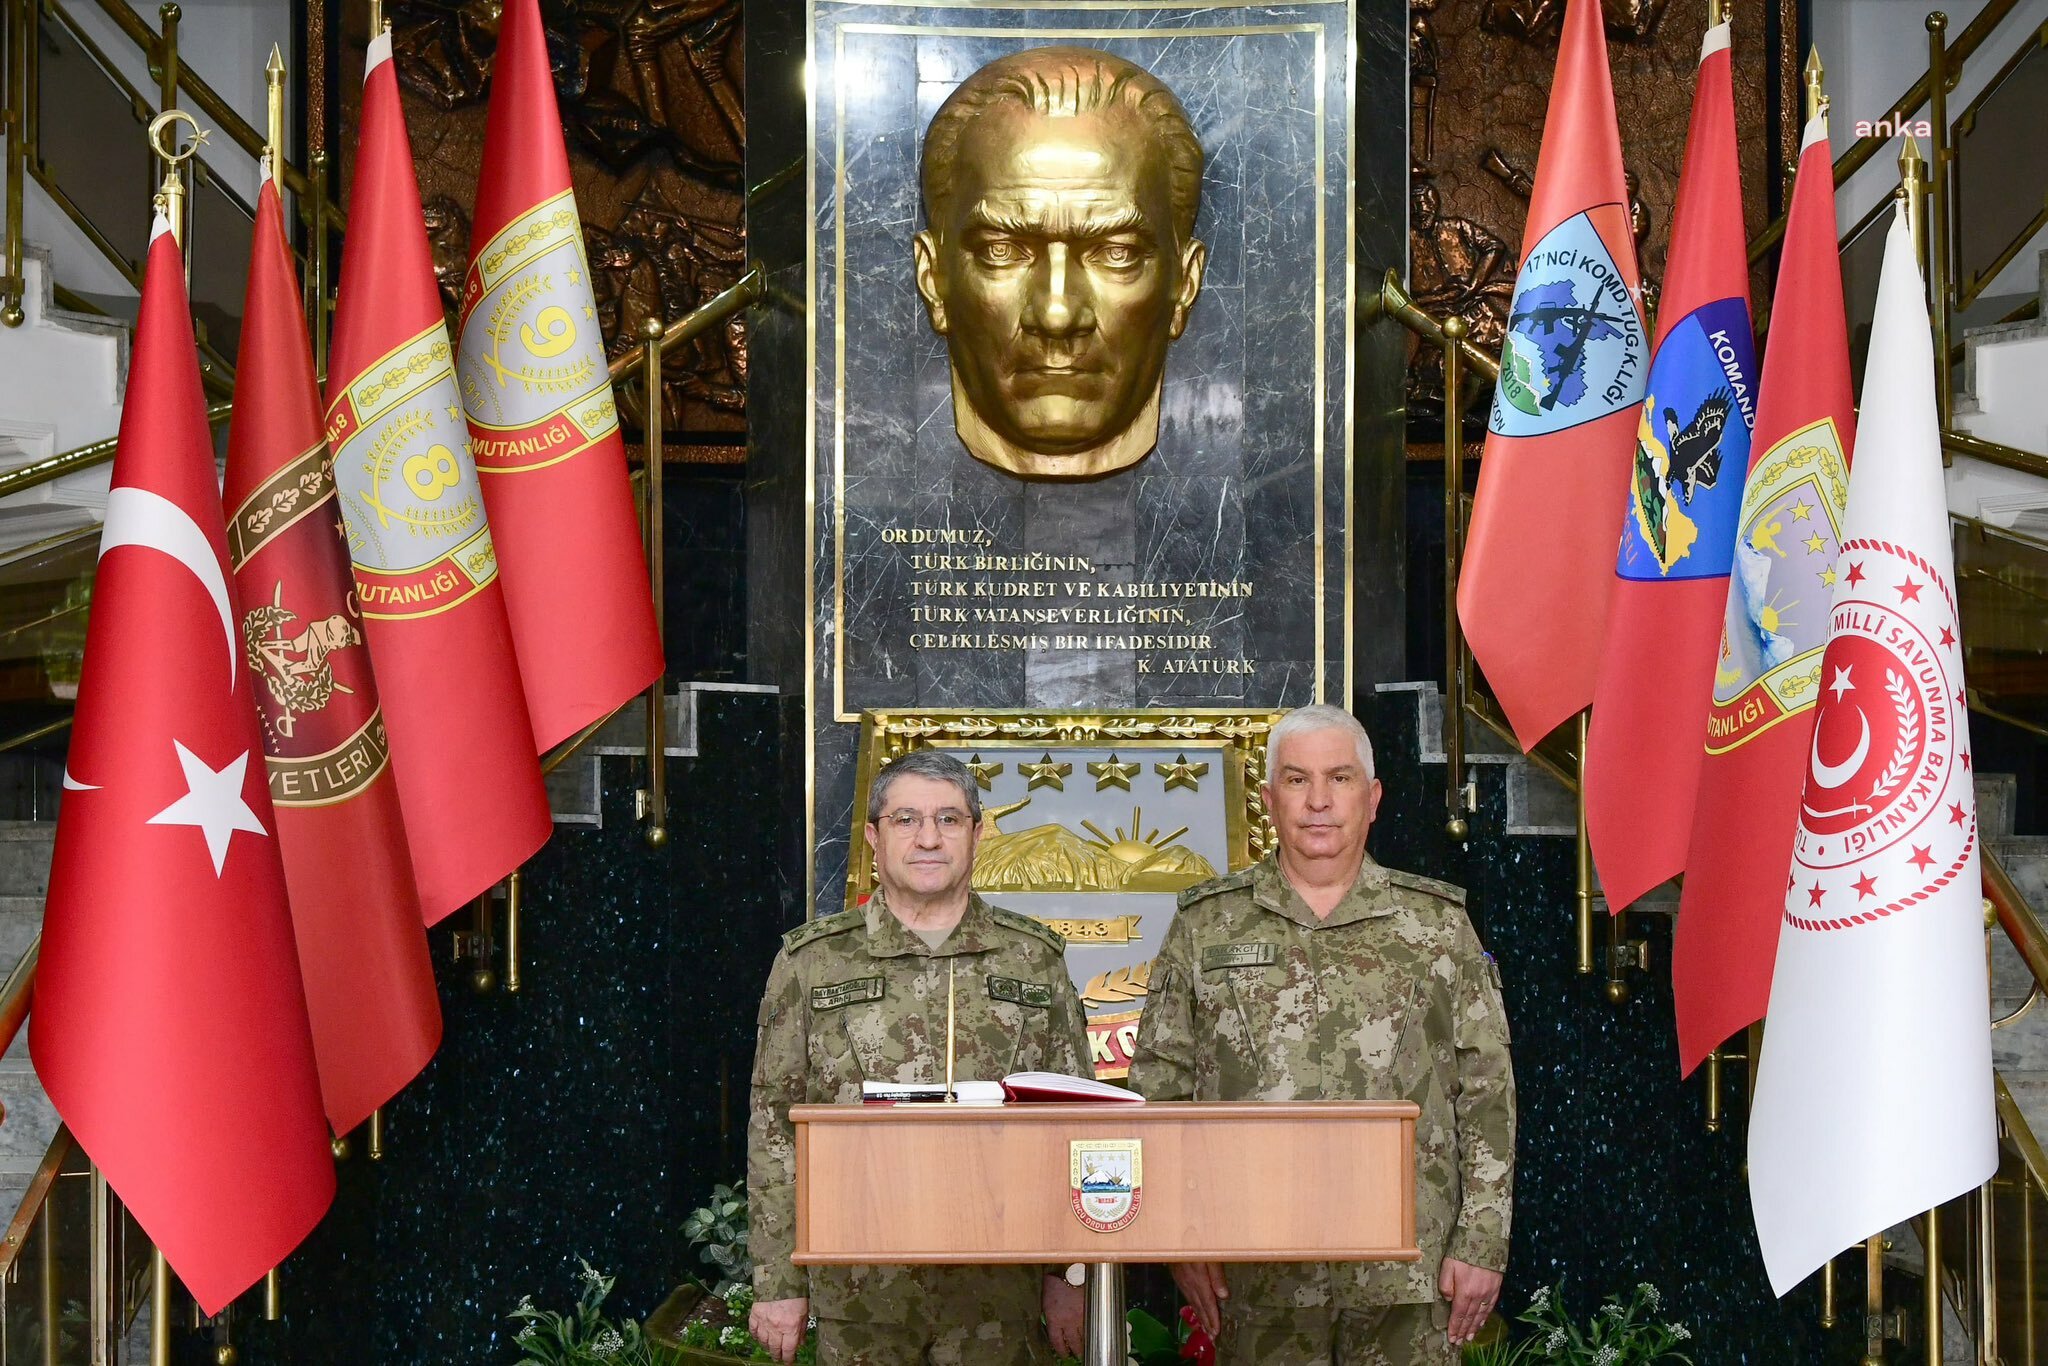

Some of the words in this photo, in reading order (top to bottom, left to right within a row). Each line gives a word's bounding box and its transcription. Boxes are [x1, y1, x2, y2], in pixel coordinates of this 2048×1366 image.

[1526, 249, 1578, 273] 17'NCİ
[1503, 362, 1521, 399] 2018
[463, 374, 487, 412] 1911
[472, 423, 572, 457] MUTANLIĞI
[402, 444, 460, 501] 8
[344, 519, 366, 554] 911
[881, 528, 992, 547] ORDUMUZ,
[911, 553, 969, 570] TÜRK
[911, 579, 968, 597] TÜRK
[974, 581, 1058, 597] KUDRET
[1064, 582, 1091, 598] VE
[911, 605, 968, 622] TÜRK
[1055, 633, 1088, 649] BİR
[1162, 657, 1256, 674] ATATÜRK
[1886, 627, 1946, 742] SAVUNMA
[1844, 752, 1944, 854] BAKANLIĞI
[1086, 1218, 1106, 1230] ORDU
